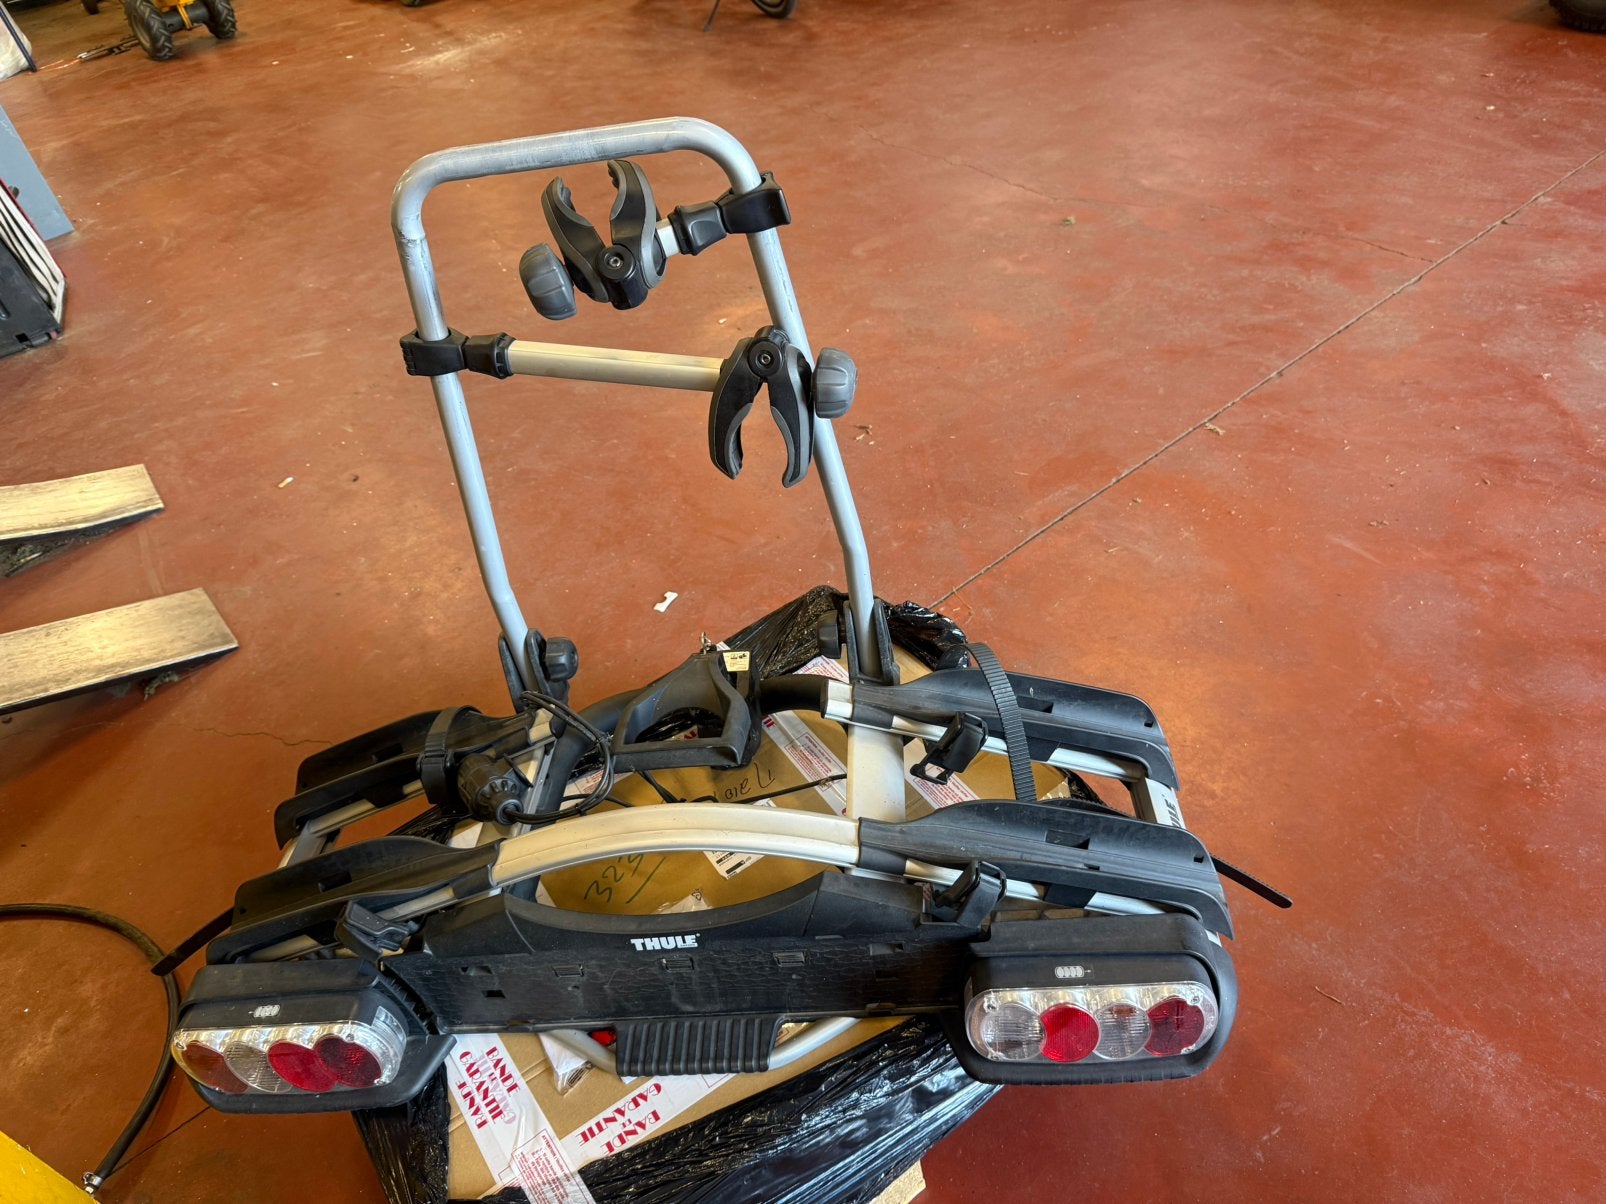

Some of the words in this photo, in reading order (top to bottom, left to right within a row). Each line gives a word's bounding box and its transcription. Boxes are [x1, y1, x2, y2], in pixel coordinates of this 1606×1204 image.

[630, 934, 698, 951] THULE
[459, 1051, 505, 1124] GARANTIE
[486, 1046, 520, 1097] BANDE
[456, 1081, 488, 1129] BANDE
[575, 1083, 662, 1146] GARANTIE
[600, 1109, 661, 1156] BANDE
